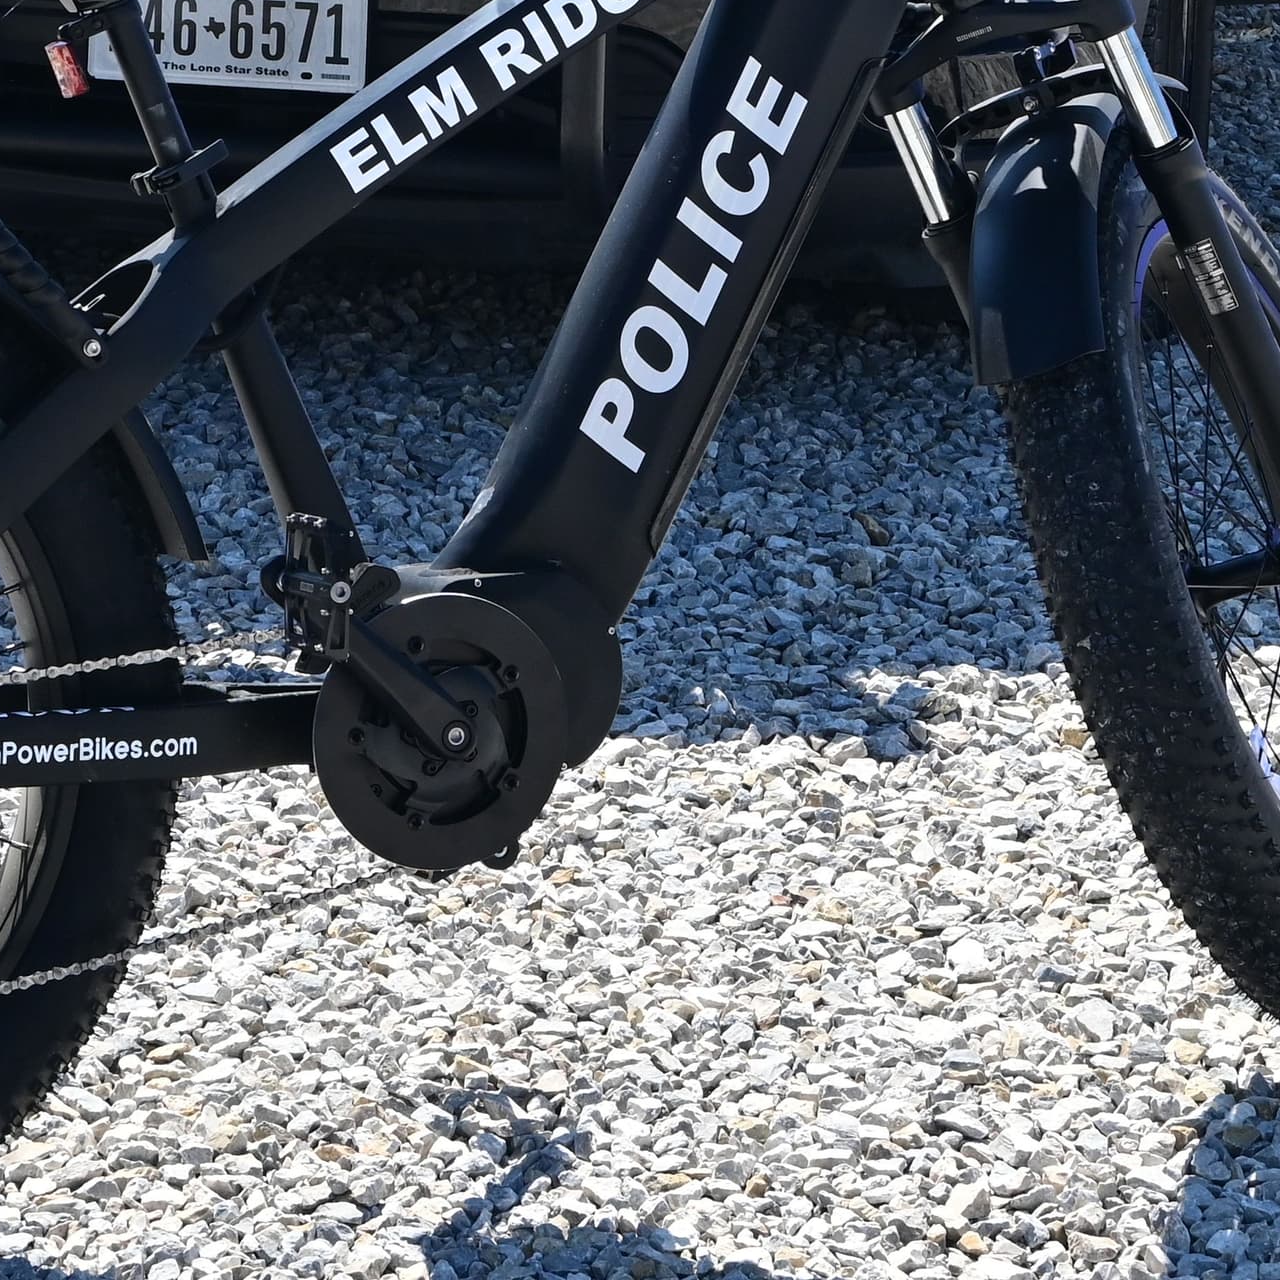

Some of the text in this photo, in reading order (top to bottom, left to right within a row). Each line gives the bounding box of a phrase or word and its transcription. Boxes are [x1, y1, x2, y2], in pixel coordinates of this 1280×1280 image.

[162, 61, 289, 77] The Lone Star State
[329, 66, 479, 194] ELM
[579, 55, 808, 474] POLICE
